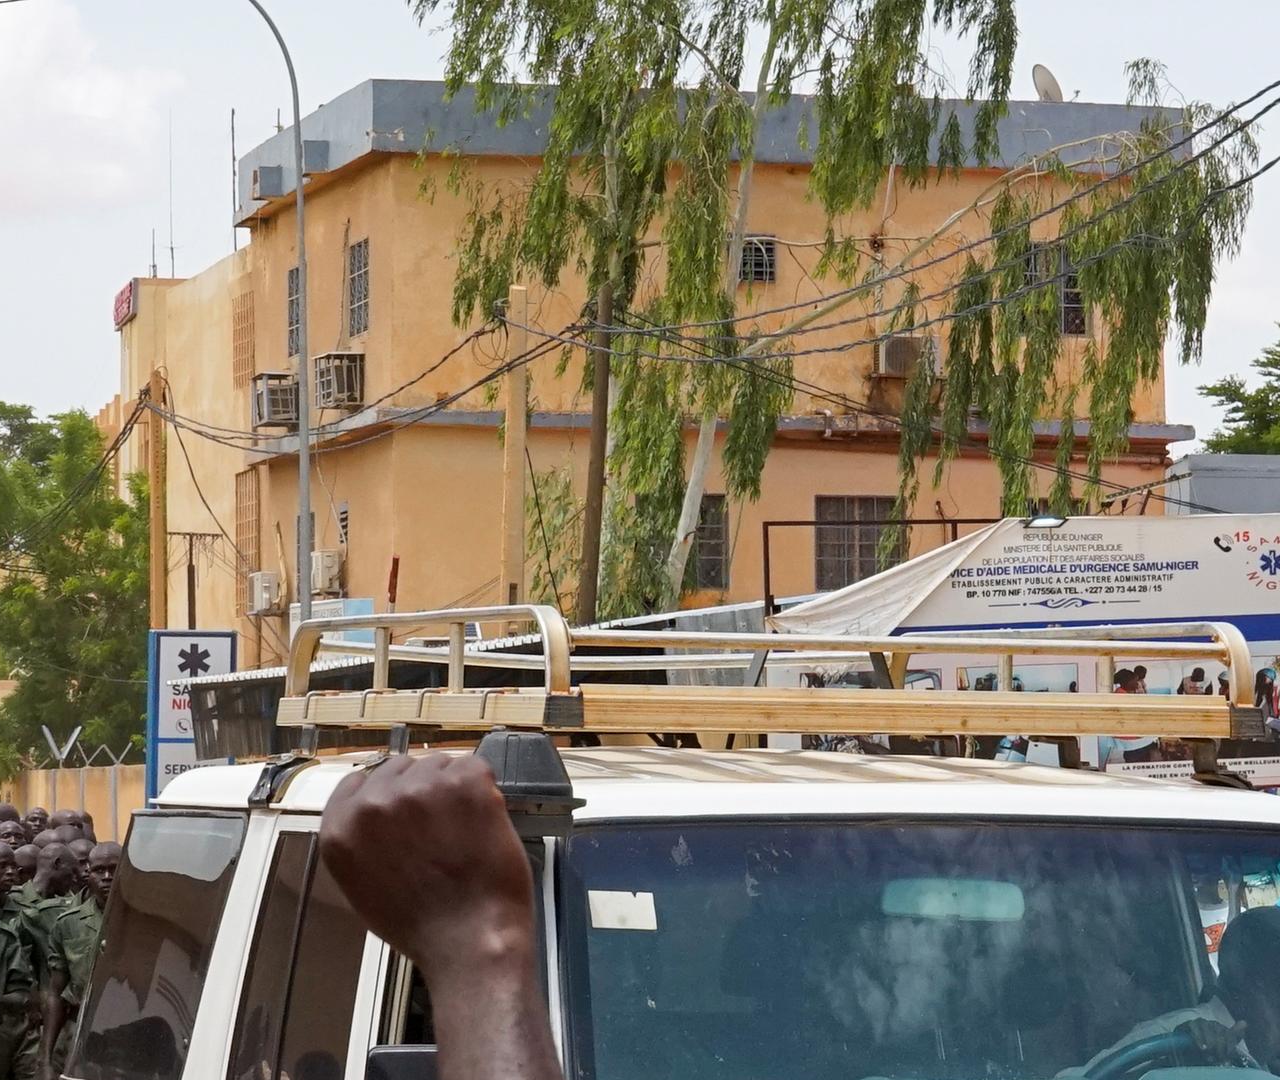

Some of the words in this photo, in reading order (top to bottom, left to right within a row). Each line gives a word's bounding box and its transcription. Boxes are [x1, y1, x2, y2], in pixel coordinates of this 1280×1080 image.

[1023, 533, 1068, 541] REPUBLIQUE
[1069, 533, 1079, 541] DU
[1081, 533, 1103, 541] NIGER
[1234, 531, 1250, 542] 15
[1004, 545, 1040, 553] MINISTERE
[1042, 544, 1052, 552] DE
[1054, 544, 1063, 552] LA
[1063, 543, 1087, 552] SANTE
[1088, 543, 1123, 552] PUBLIQUE
[982, 558, 993, 566] DE
[1004, 556, 1048, 565] POPULATION
[1050, 554, 1058, 562] ET
[1060, 554, 1074, 562] DES
[1076, 554, 1109, 562] AFFAIRES
[1111, 553, 1145, 562] SOCIALES
[949, 567, 974, 578] VICE
[977, 566, 1010, 577] D'AIDE
[1013, 564, 1067, 574] MEDICALE
[1070, 562, 1130, 573] D'URGENCE
[1133, 560, 1199, 571] SAMU-NIGER
[1024, 576, 1053, 585] PUBLIC
[1056, 576, 1062, 584] A
[1063, 575, 1112, 584] CARACTERE
[1114, 573, 1174, 583] ADMINISTRATIF
[1116, 585, 1125, 593] 73
[1153, 584, 1162, 592] 15
[172, 685, 193, 697] SA
